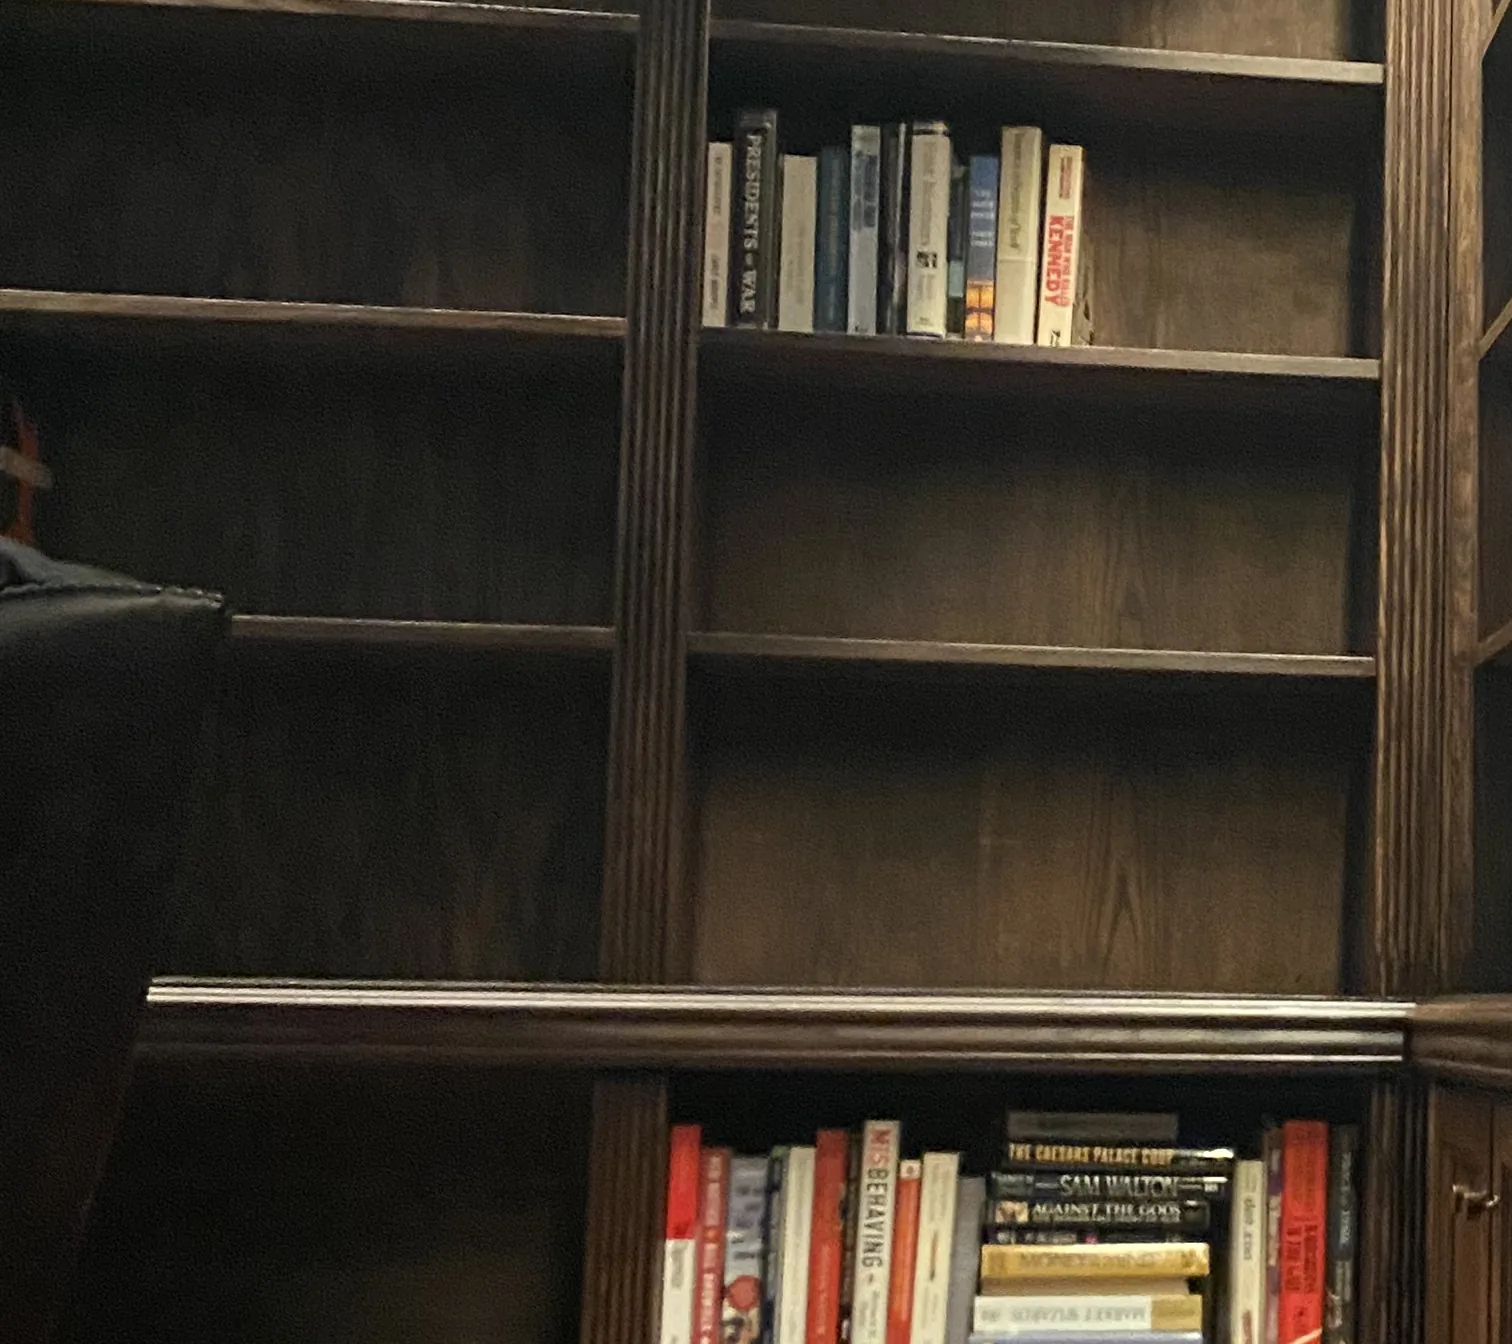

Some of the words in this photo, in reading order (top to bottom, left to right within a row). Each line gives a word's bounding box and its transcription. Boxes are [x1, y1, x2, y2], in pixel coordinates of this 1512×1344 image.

[743, 134, 762, 249] PRESIDENTS
[1045, 214, 1064, 306] KENNEDY
[740, 270, 757, 314] WAR
[1093, 1146, 1136, 1164] PALACE
[861, 1129, 892, 1268] MISBEHAVING
[1060, 1175, 1100, 1195] SAM
[1106, 1176, 1179, 1197] WALTON
[1032, 1202, 1098, 1217] AGAINST
[1103, 1204, 1136, 1217] THE
[1139, 1202, 1180, 1216] GODS
